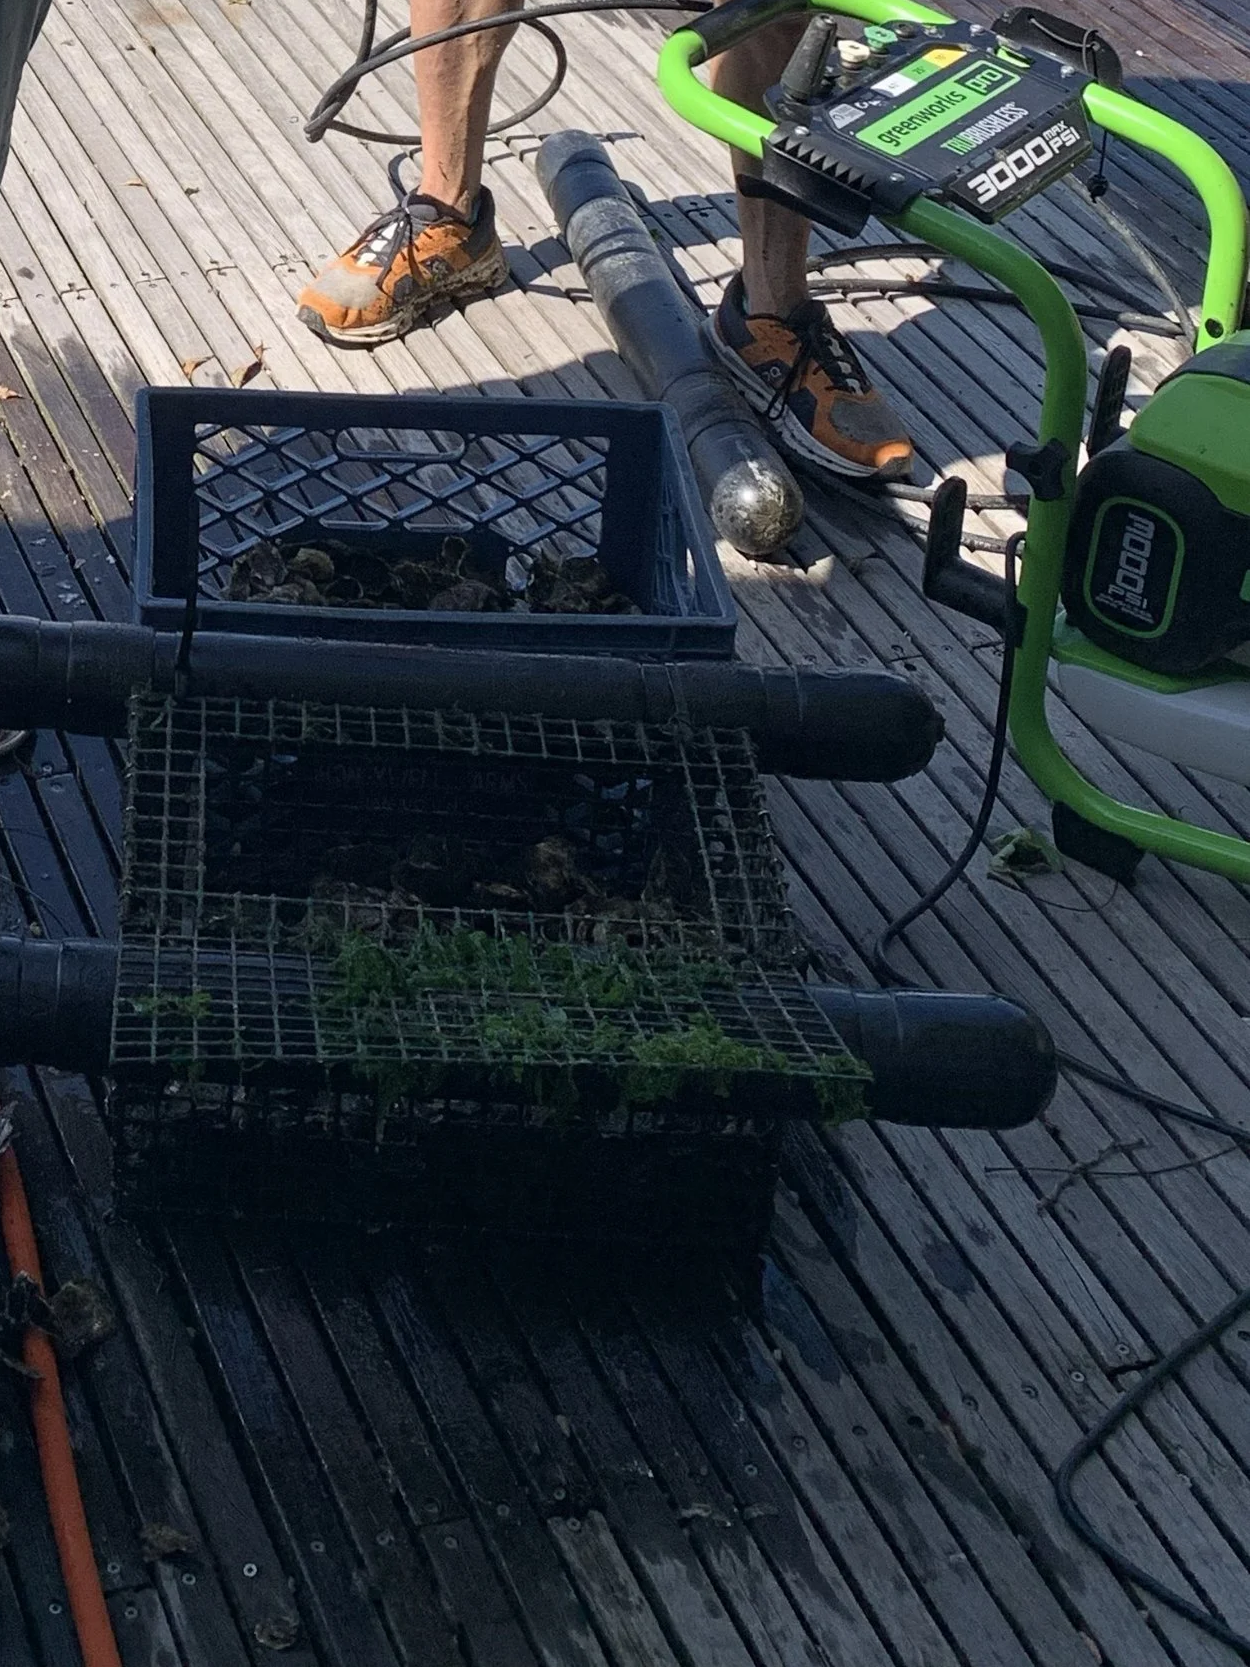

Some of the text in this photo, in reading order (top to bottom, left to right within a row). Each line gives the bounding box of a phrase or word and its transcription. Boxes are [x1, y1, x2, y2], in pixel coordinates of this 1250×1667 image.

[877, 68, 1004, 147] greenworks pro
[940, 103, 1030, 156] TRUBRUSHLESS
[1048, 127, 1082, 154] PSI
[967, 120, 1070, 205] 3000 MAX
[1115, 513, 1156, 594] 3000
[1108, 584, 1148, 610] PSI
